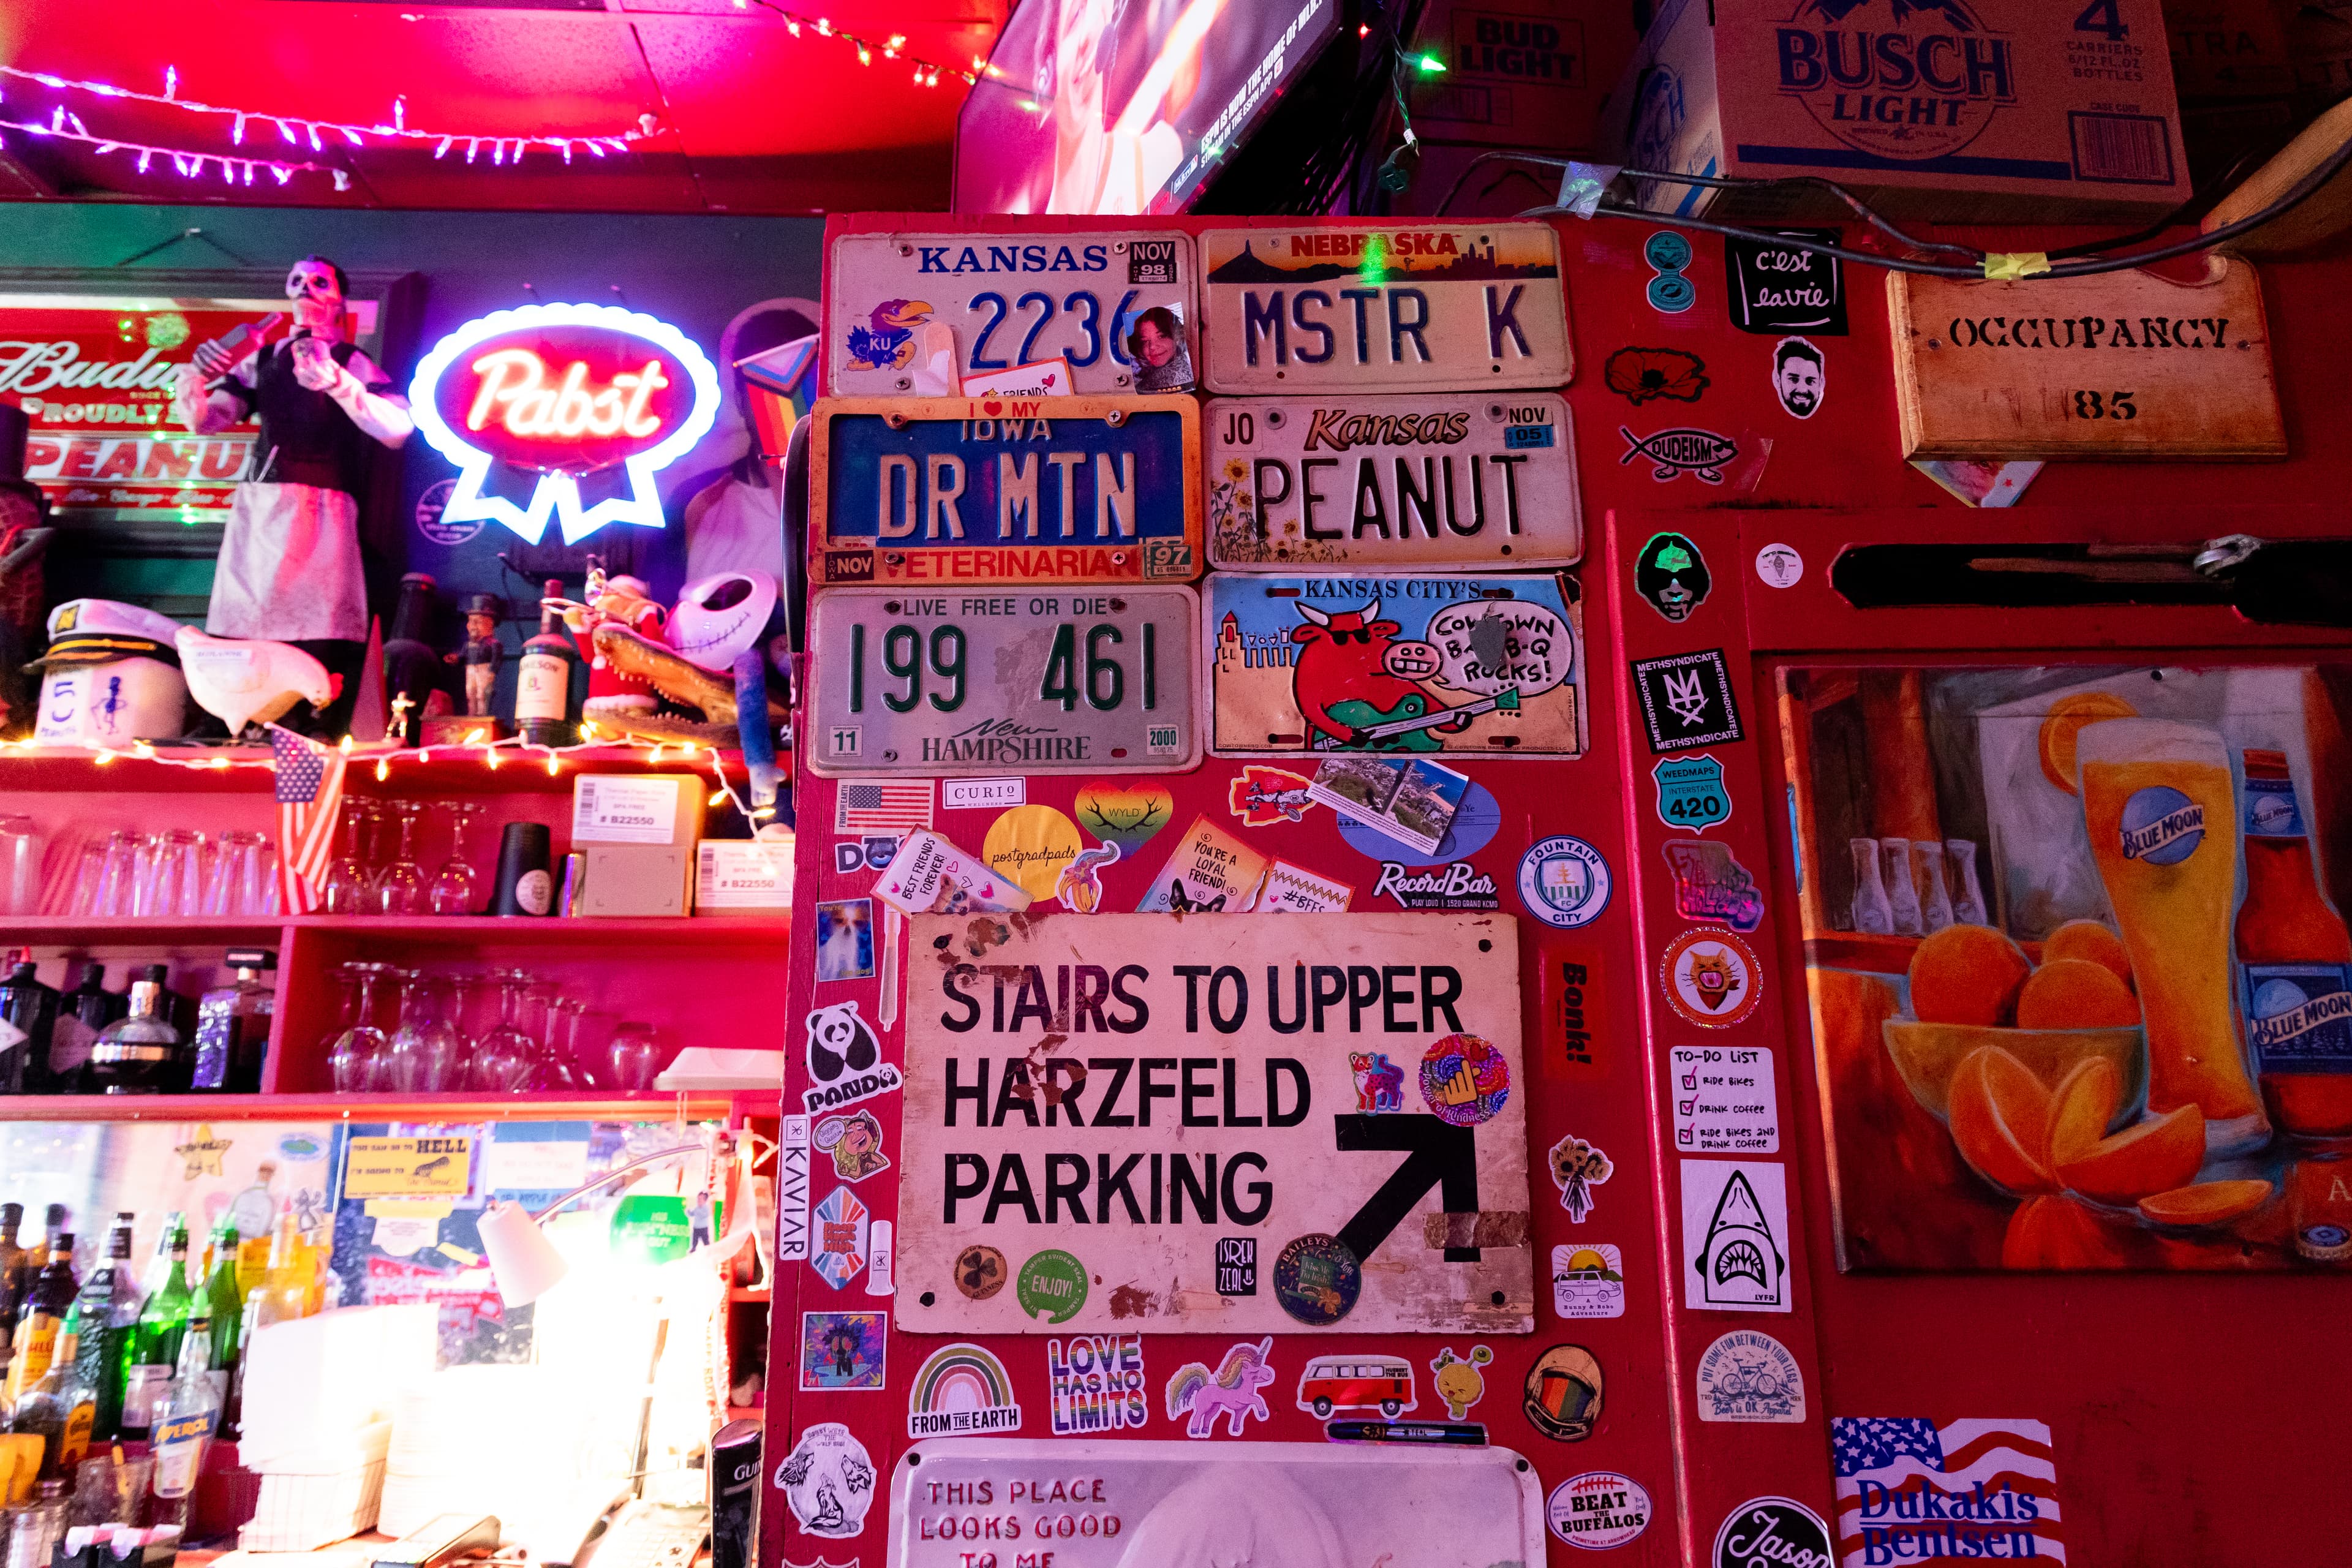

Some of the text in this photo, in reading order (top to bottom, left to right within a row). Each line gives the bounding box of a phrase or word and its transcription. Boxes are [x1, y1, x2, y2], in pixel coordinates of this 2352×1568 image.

[1476, 18, 1561, 50] BUD
[2066, 40, 2144, 56] CARRIERS
[1460, 45, 1577, 79] LIGHT
[1777, 28, 2014, 100] BUSCH
[2073, 67, 2144, 82] BOTTLES
[1201, 20, 1297, 154] ESPN IS NOW THE HOME OF
[1224, 72, 1273, 140] IN THE ESPN APP
[1832, 94, 1967, 127] LIGHT
[2090, 102, 2114, 111] CASE
[1134, 243, 1172, 260] NOV
[1291, 232, 1459, 257] NEBRASKA
[918, 245, 1108, 273] KANSAS
[1140, 265, 1166, 275] 98
[1243, 284, 1531, 368] MSTR K
[869, 336, 891, 352] KU
[467, 347, 669, 439] Pabst
[2075, 390, 2138, 421] 85
[20, 396, 163, 424] PROUDLY
[970, 401, 1041, 418] I MY
[1509, 407, 1545, 423] NOV
[962, 419, 1052, 442] IOWA
[1223, 412, 1254, 446] JO
[1304, 409, 1470, 452] Kansas
[1516, 429, 1542, 440] 05
[1652, 436, 1714, 462] DUDEISM
[878, 452, 1136, 540] DR MTN
[1253, 453, 1528, 541] PEANUT
[837, 557, 873, 574] NOV
[1155, 547, 1188, 565] 97
[1304, 579, 1481, 599] KANSAS CITY'S
[903, 598, 1107, 616] LIVE FREE OR DIE
[848, 623, 1156, 714] 199 461
[1463, 660, 1551, 682] ROCKS!
[1636, 651, 1719, 673] METHSYNDICATE
[1637, 671, 1662, 742] METHSYNDICATE
[1714, 660, 1737, 731] METHSYNDICATE
[952, 718, 1058, 737] New
[1150, 730, 1176, 745] 2000
[1656, 729, 1740, 751] METHSYNDICATE
[834, 731, 856, 752] 11
[922, 735, 1091, 762] HAMPSHIRE
[1662, 766, 1715, 780] WEEDMAPS
[954, 785, 1014, 799] CURIO
[1668, 784, 1715, 794] INTERSTATE
[611, 815, 654, 826] B22550
[839, 812, 848, 827] FROM
[1109, 808, 1139, 818] WYLD
[1669, 796, 1721, 820] 420
[2253, 805, 2294, 826] BLUE MOON
[2121, 808, 2204, 860] BLUE MOON
[991, 845, 1076, 870] postgradpads
[1230, 854, 1238, 867] A
[1528, 841, 1599, 867] FOUNTAIN
[902, 837, 936, 900] BEST FRIENDS
[919, 853, 948, 895] FOREVER!
[1195, 856, 1227, 878] LOYAL
[1188, 869, 1227, 894] FRIEND!
[1553, 913, 1583, 923] CITY
[940, 963, 1466, 1035] STAIRS TO UPPER
[1562, 962, 1593, 1066] Bonk!
[2252, 994, 2352, 1045] BLUE MOON
[1674, 1050, 1722, 1063] TO-DO
[942, 1057, 1311, 1128] HARZFELD
[416, 1139, 467, 1154] HELL
[783, 1146, 807, 1255] KAVIAR
[942, 1150, 1274, 1226] PARKING
[1282, 1237, 1330, 1263] BAILEYS
[1024, 1253, 1083, 1284] TAMPER EVIDENT SEAL
[1219, 1268, 1243, 1291] ZEAL
[972, 1279, 1004, 1299] GUINNESS
[1031, 1274, 1073, 1299] ENJOY!
[1057, 1297, 1080, 1318] TAMPER
[1052, 1336, 1142, 1376] LOVE
[1702, 1333, 1798, 1384] PUT SOME FUN BETWEEN YOUR LEGS
[1053, 1370, 1142, 1395] HAS NO
[1053, 1389, 1147, 1432] LIMITS
[1746, 1401, 1758, 1412] OK
[154, 1417, 209, 1444] APEROL
[911, 1408, 1018, 1434] FROM THE EARTH
[927, 1479, 1107, 1506] THIS PLACE
[1570, 1491, 1628, 1513] BEAT
[1856, 1480, 2039, 1519] Dukakis
[920, 1514, 1121, 1540] LOOKS GOOD
[1561, 1513, 1645, 1534] BUFFALOS
[1861, 1523, 2037, 1566] Bentsen
[959, 1551, 1055, 1568] TO ME
